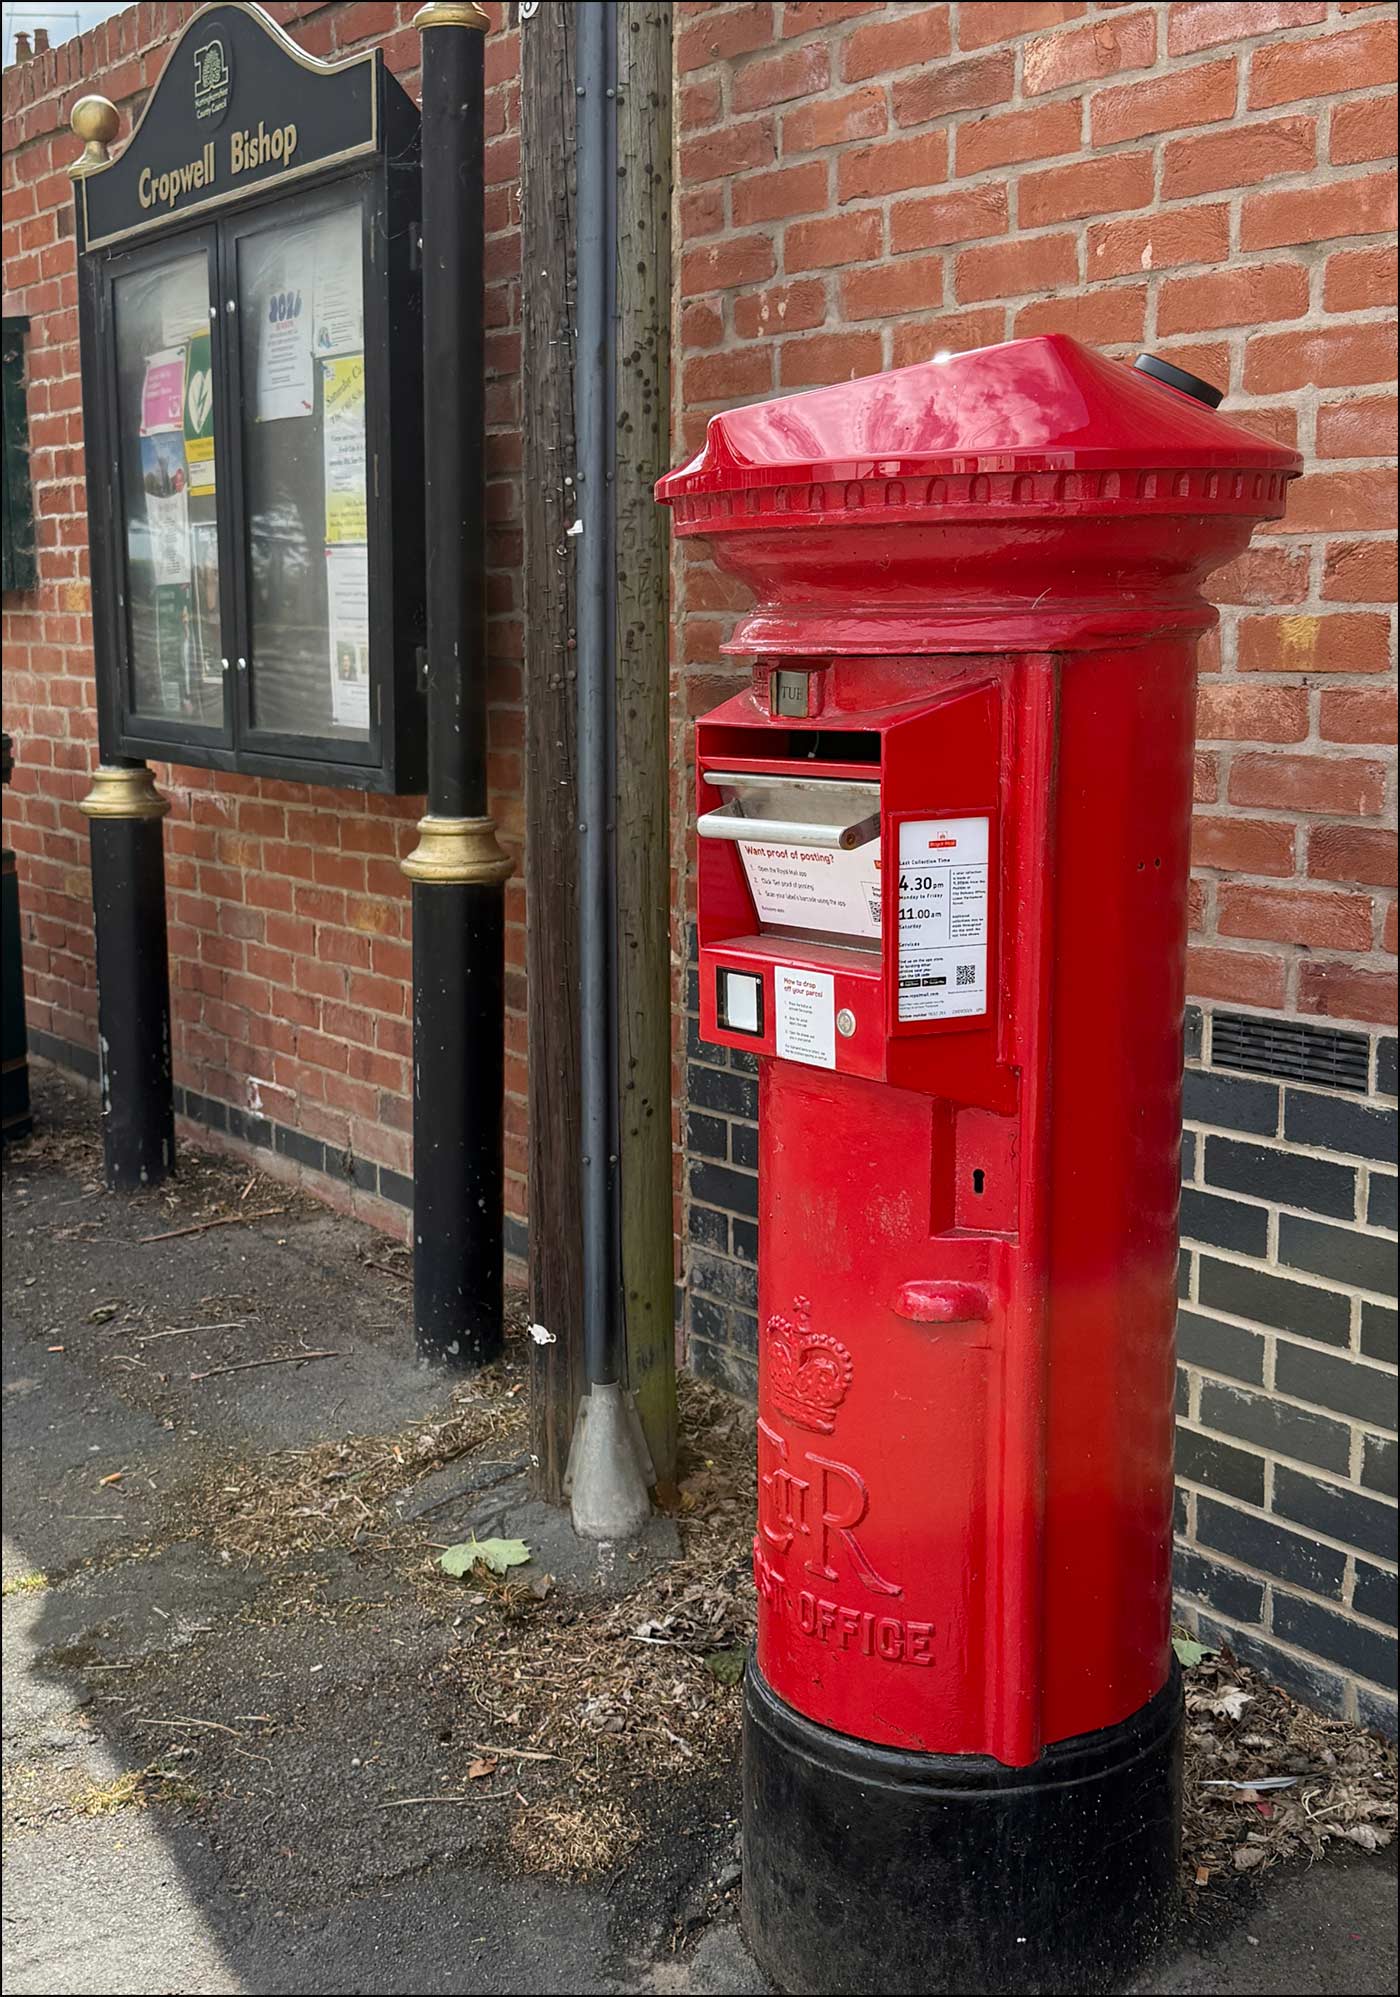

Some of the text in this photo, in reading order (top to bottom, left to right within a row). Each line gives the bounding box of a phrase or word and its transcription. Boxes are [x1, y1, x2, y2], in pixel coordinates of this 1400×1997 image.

[196, 98, 227, 119] County Council
[138, 121, 297, 208] Cropwell Bishop
[782, 687, 803, 701] TUE
[744, 845, 834, 864] Want proof of posting?
[783, 977, 795, 985] How
[803, 980, 816, 989] drop
[792, 988, 804, 996] your
[805, 989, 823, 998] parcel
[800, 1590, 935, 1666] OFFICE
